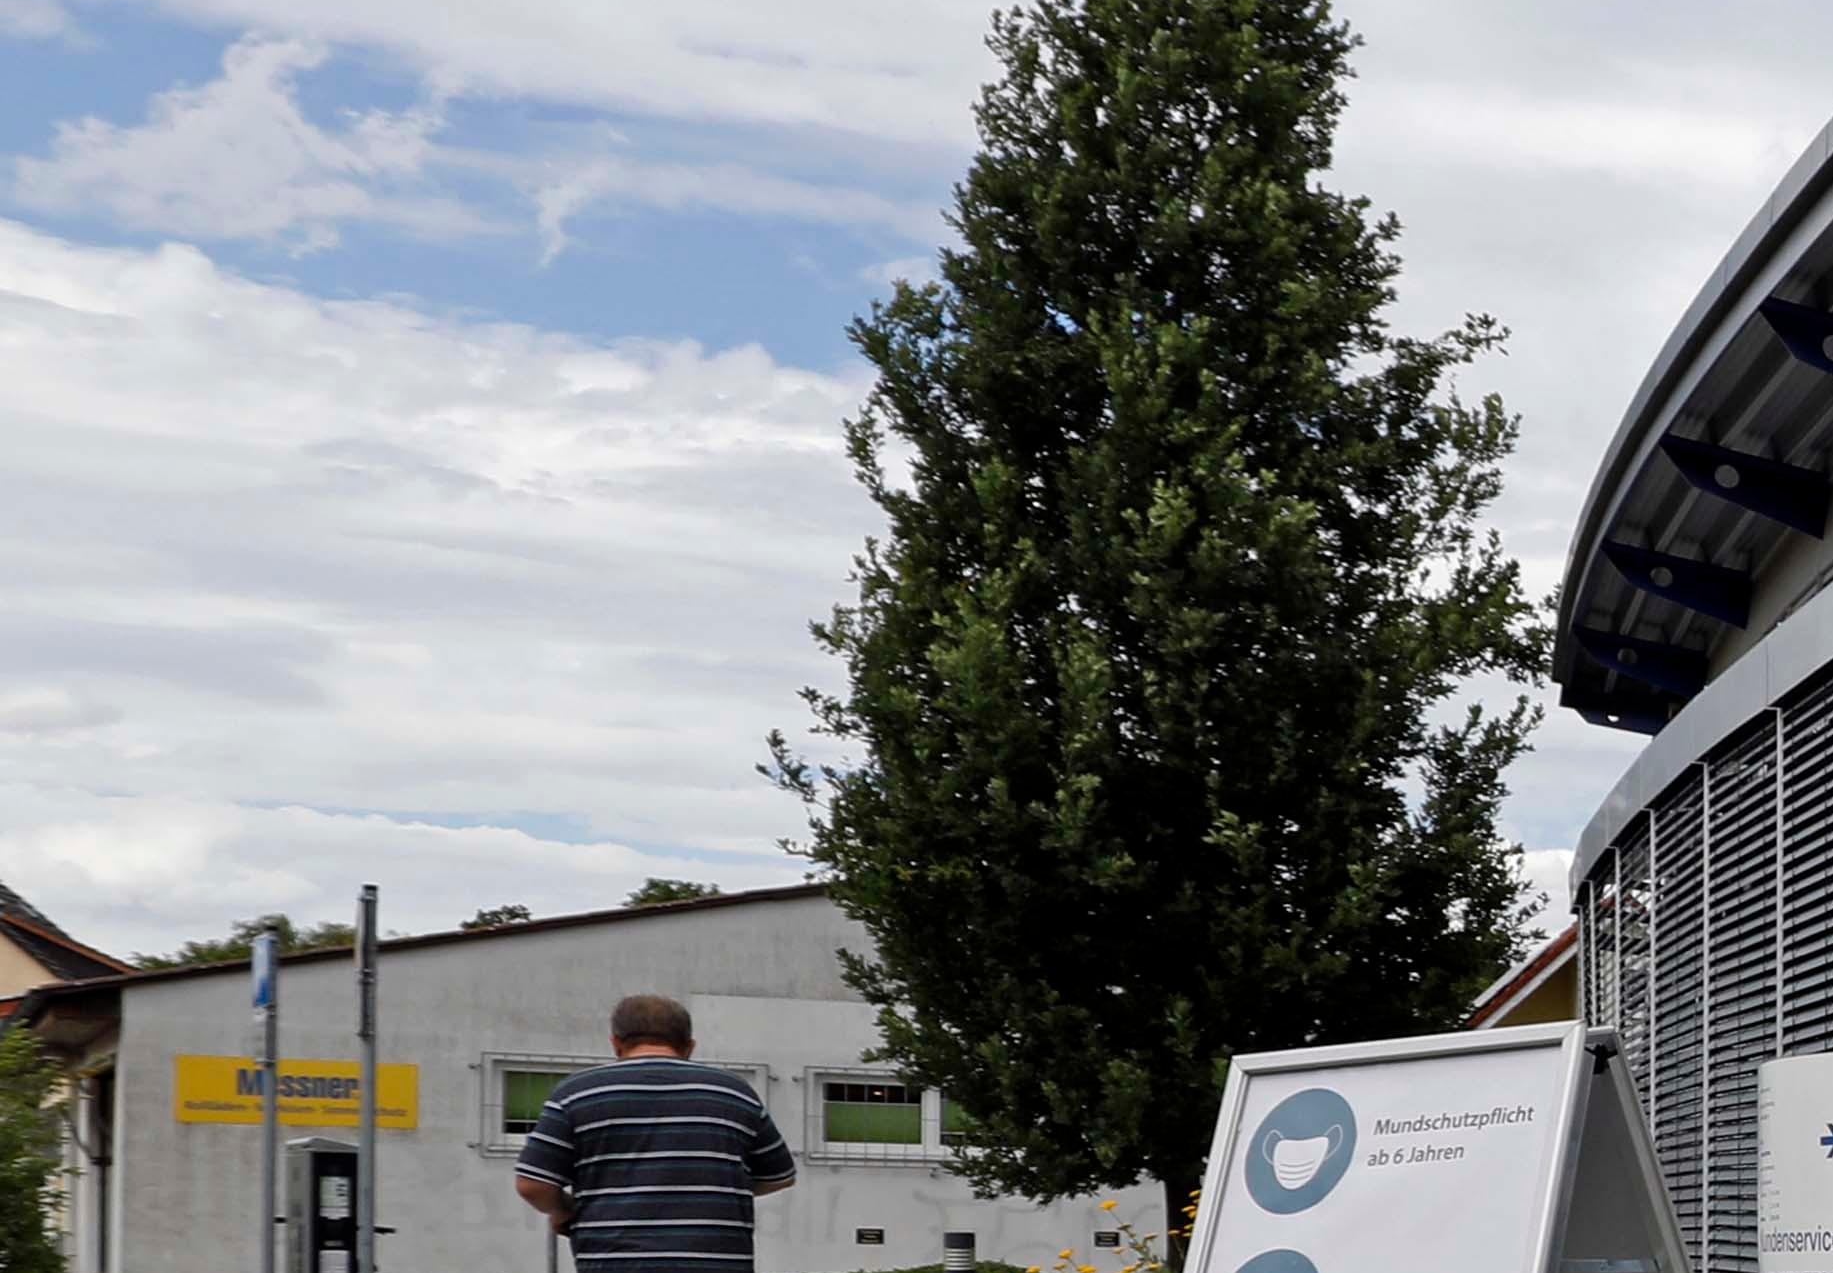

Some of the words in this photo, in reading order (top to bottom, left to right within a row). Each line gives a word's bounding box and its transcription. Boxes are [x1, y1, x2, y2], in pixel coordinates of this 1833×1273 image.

[236, 1068, 360, 1100] Mssner
[1373, 1105, 1535, 1136] Mundschutzpflicht
[1367, 1148, 1390, 1167] ab
[1393, 1148, 1405, 1165] 6
[1406, 1144, 1465, 1164] Jahren
